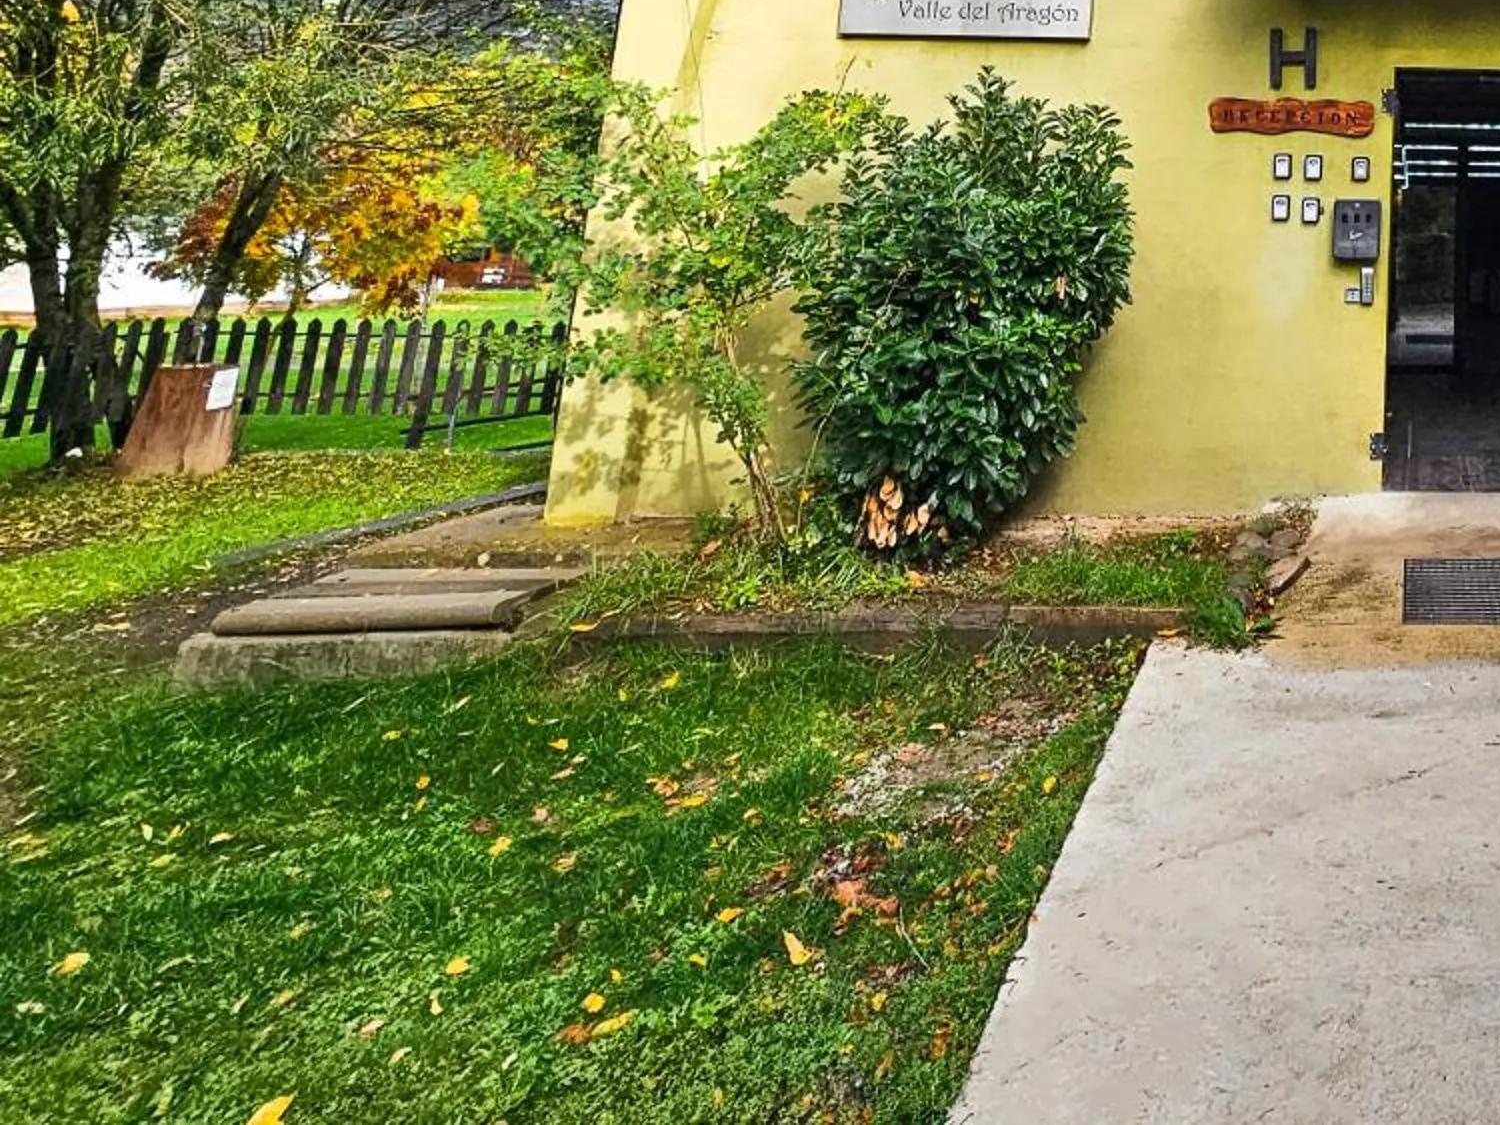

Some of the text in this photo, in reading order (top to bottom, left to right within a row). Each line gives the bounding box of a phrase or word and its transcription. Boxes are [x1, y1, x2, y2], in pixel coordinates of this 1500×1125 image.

[899, 0, 1079, 25] Valle del Aragón
[1269, 27, 1317, 90] H
